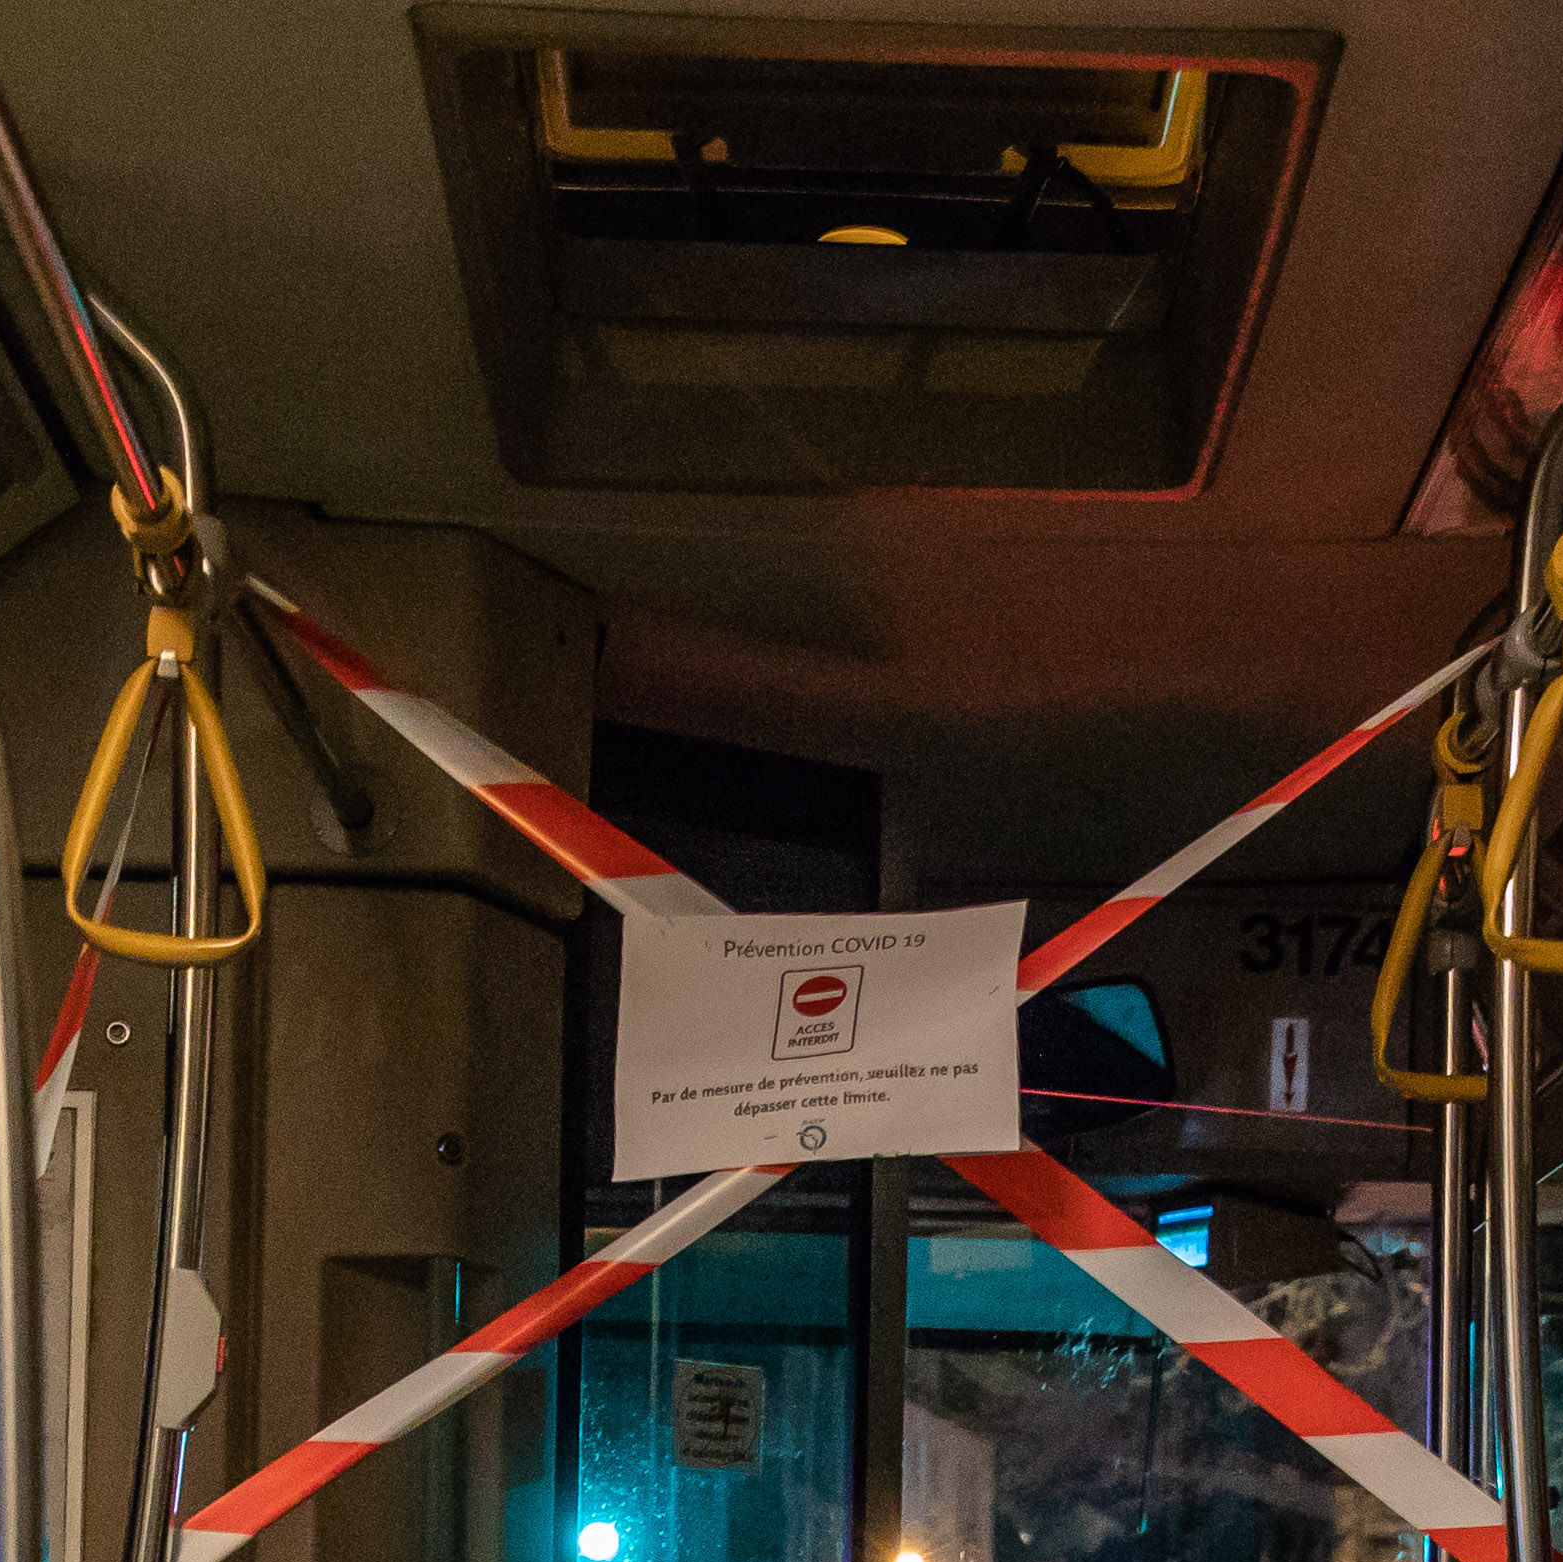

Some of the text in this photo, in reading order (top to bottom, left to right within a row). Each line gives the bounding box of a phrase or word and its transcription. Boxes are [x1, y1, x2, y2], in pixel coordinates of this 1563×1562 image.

[724, 934, 926, 959] Prévention COVID 19
[1240, 913, 1395, 976] 3174
[788, 1032, 840, 1048] INTERDIT
[795, 1021, 835, 1036] ACCES
[651, 1063, 979, 1104] Par de mesure de prévention, veuillez ne pas
[733, 1090, 891, 1118] dépasser cette limite.
